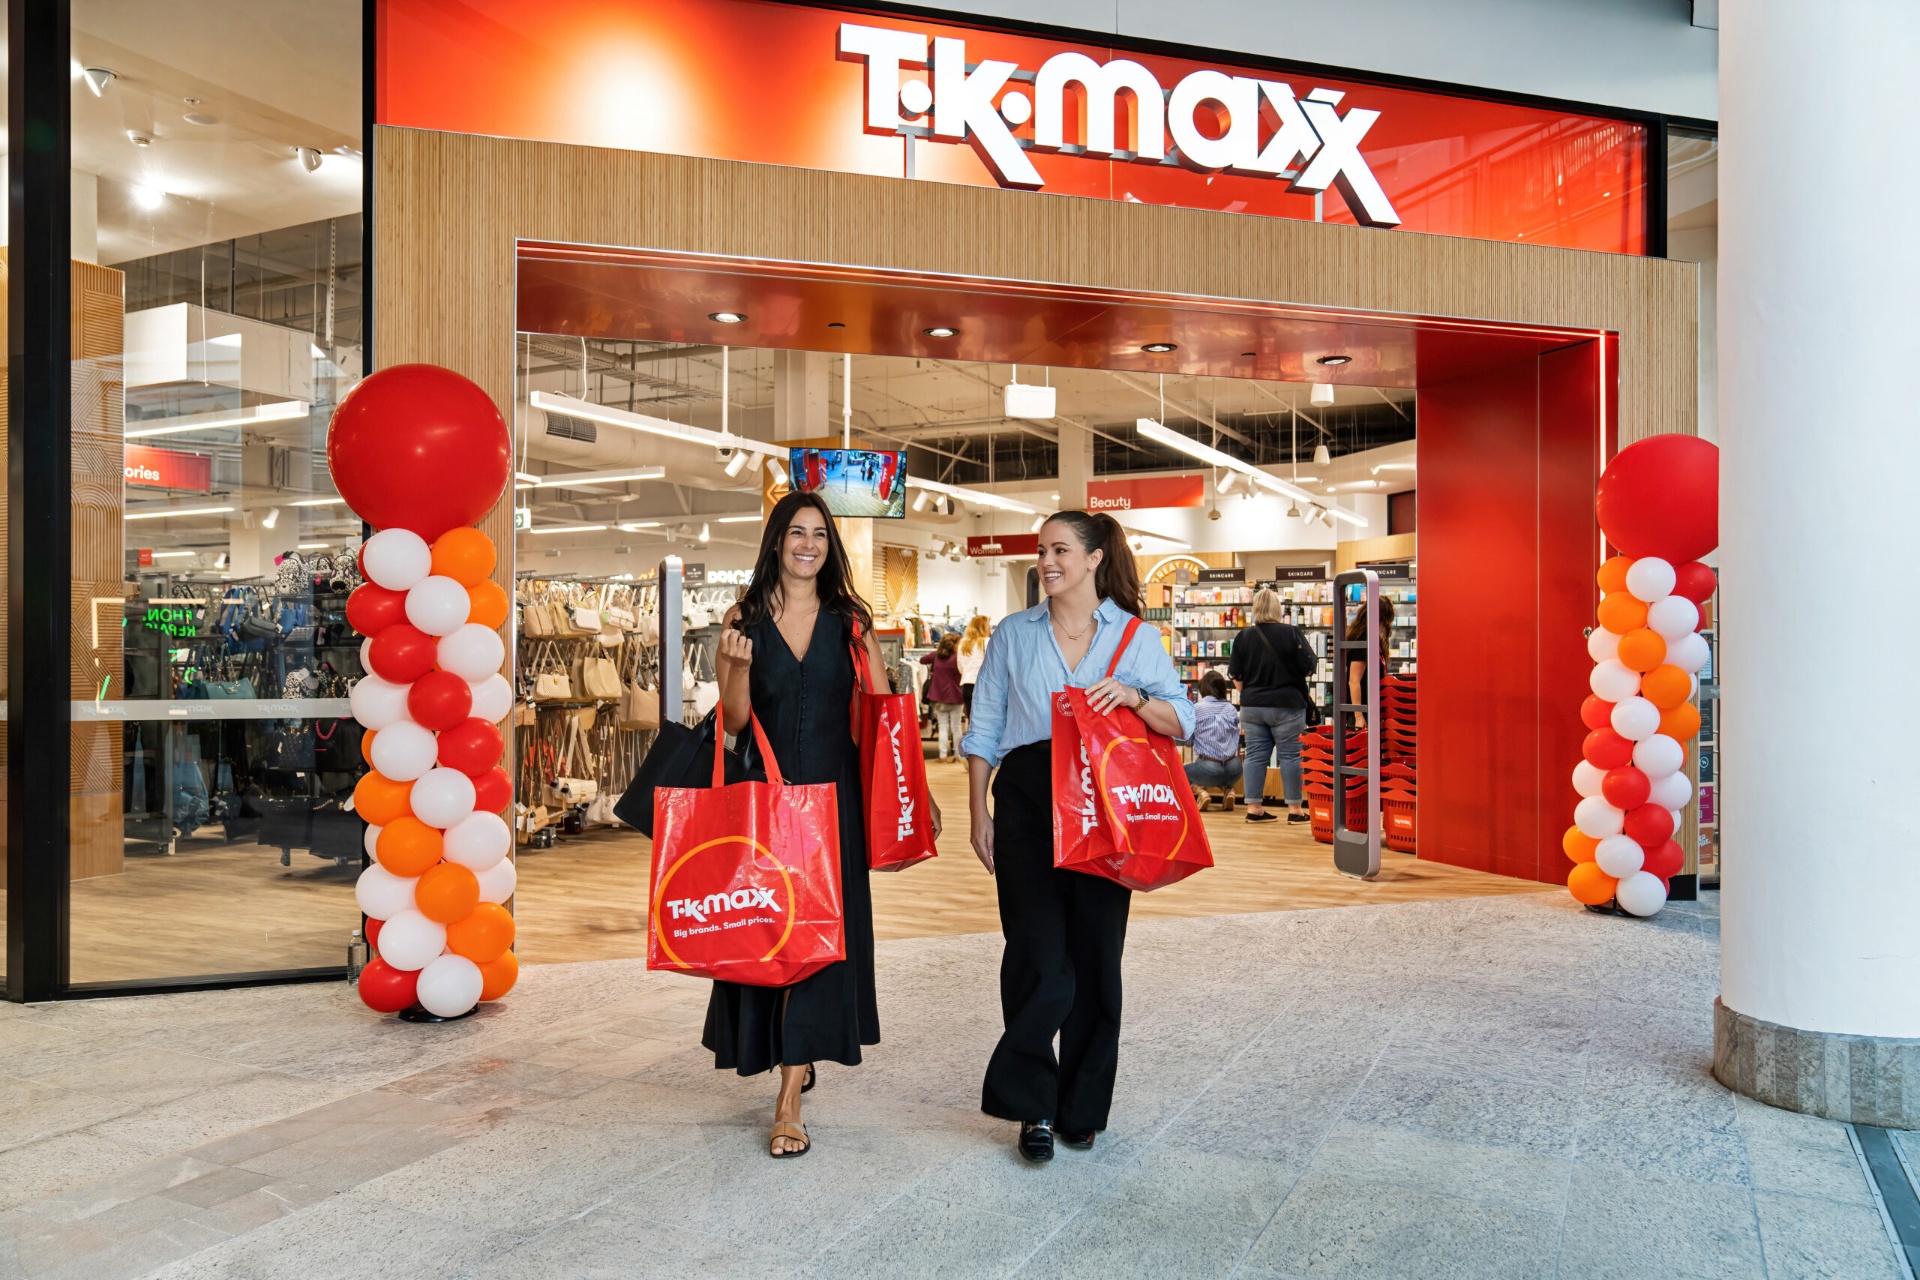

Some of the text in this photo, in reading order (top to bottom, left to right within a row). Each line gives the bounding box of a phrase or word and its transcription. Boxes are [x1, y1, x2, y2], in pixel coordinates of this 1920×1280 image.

[124, 465, 159, 481] ories
[1090, 496, 1131, 510] Beauty
[1145, 812, 1161, 820] Small
[673, 916, 776, 938] Big brands. Small prices.
